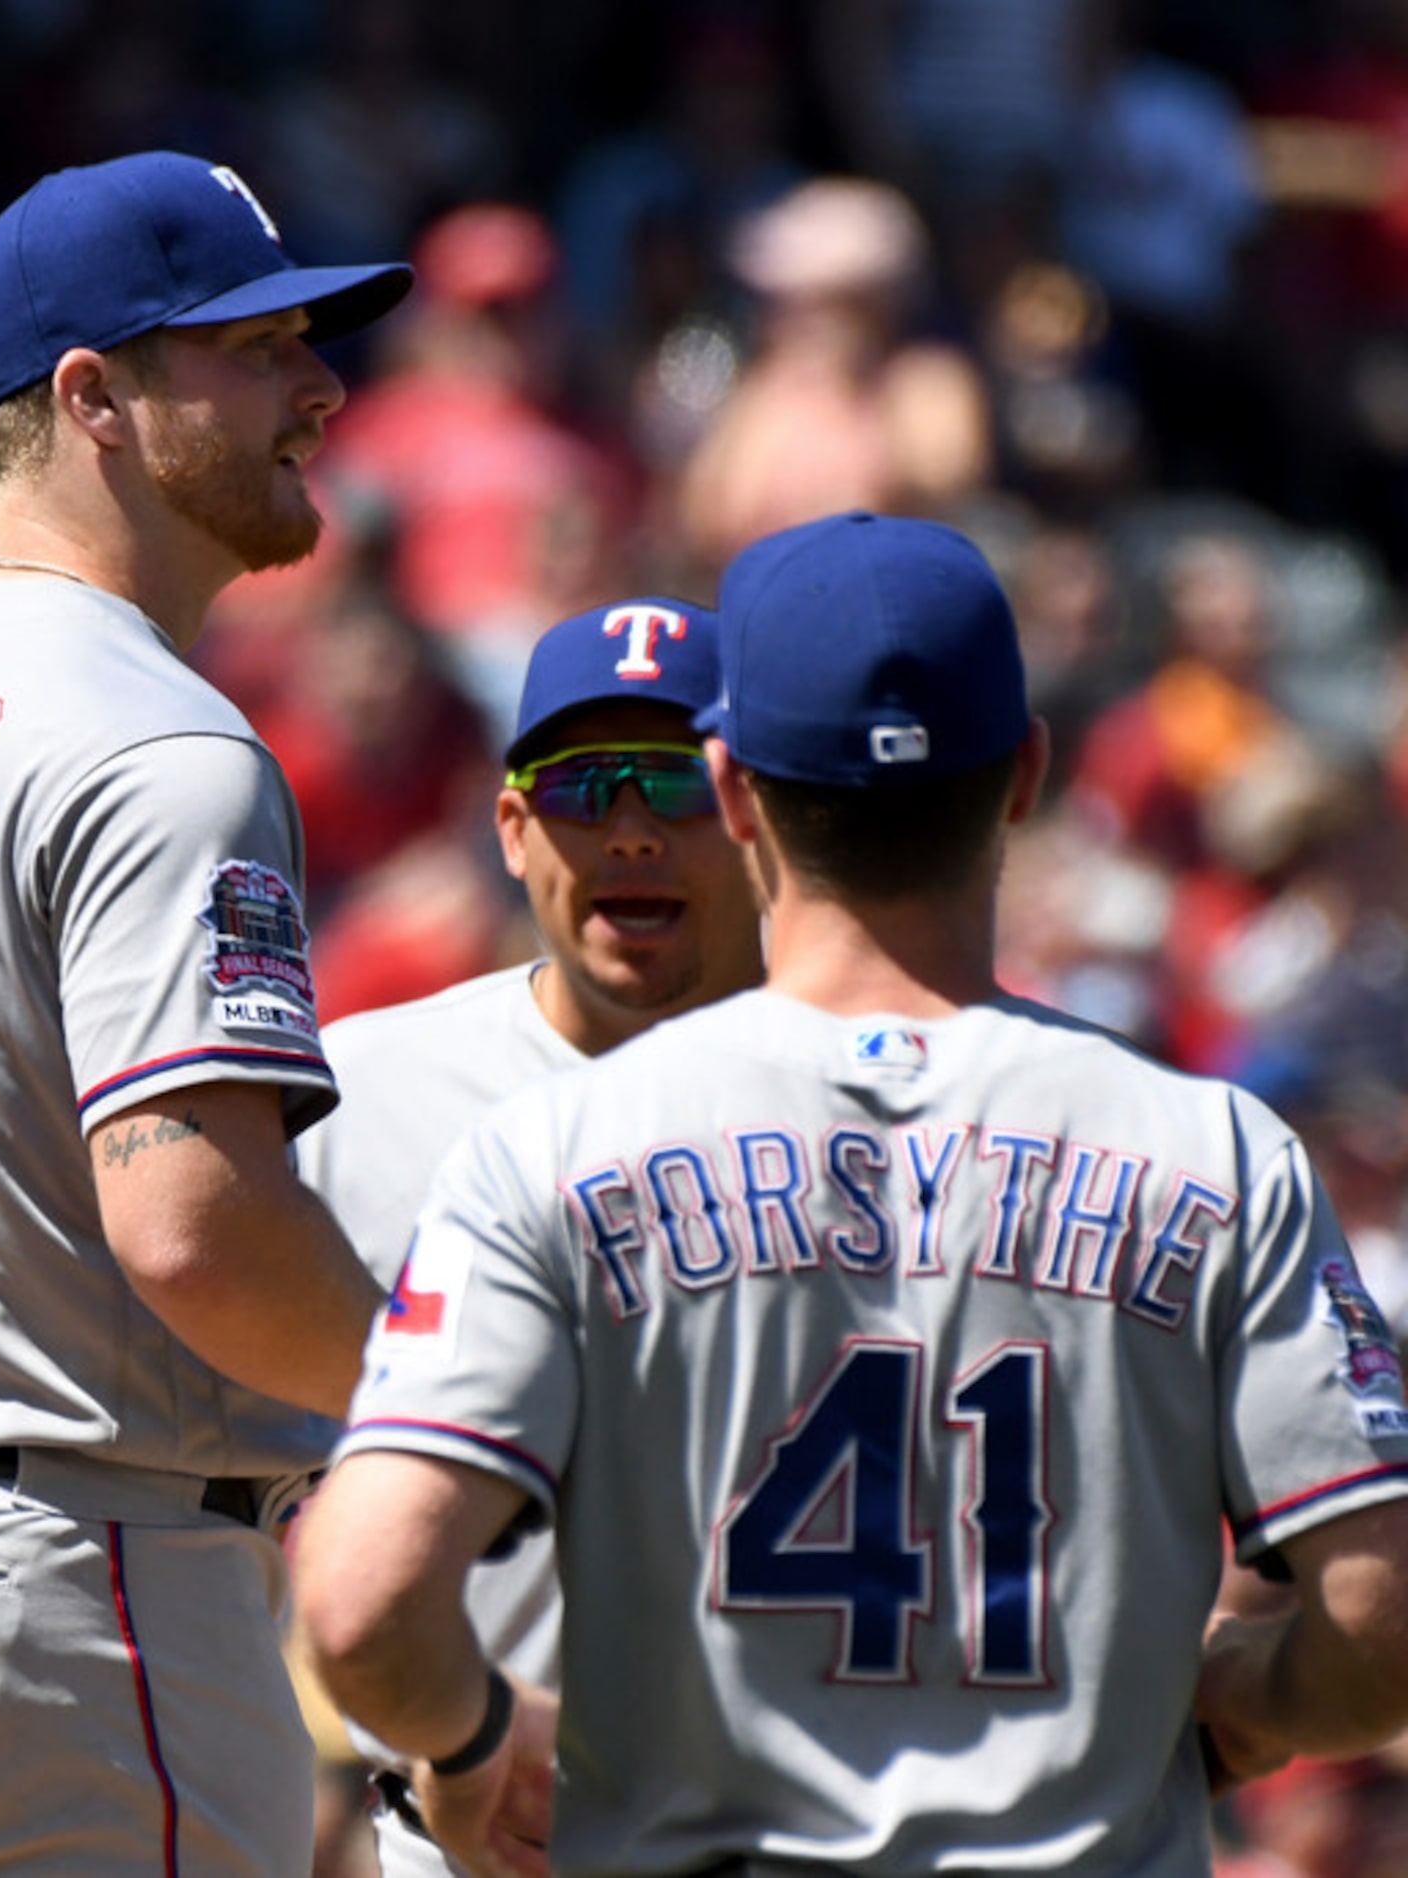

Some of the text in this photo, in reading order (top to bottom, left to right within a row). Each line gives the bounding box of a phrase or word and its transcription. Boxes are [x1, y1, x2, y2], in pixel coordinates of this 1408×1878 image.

[602, 605, 688, 681] T
[558, 1122, 1242, 1333] FORSYTHE
[710, 1335, 1059, 1690] 41
